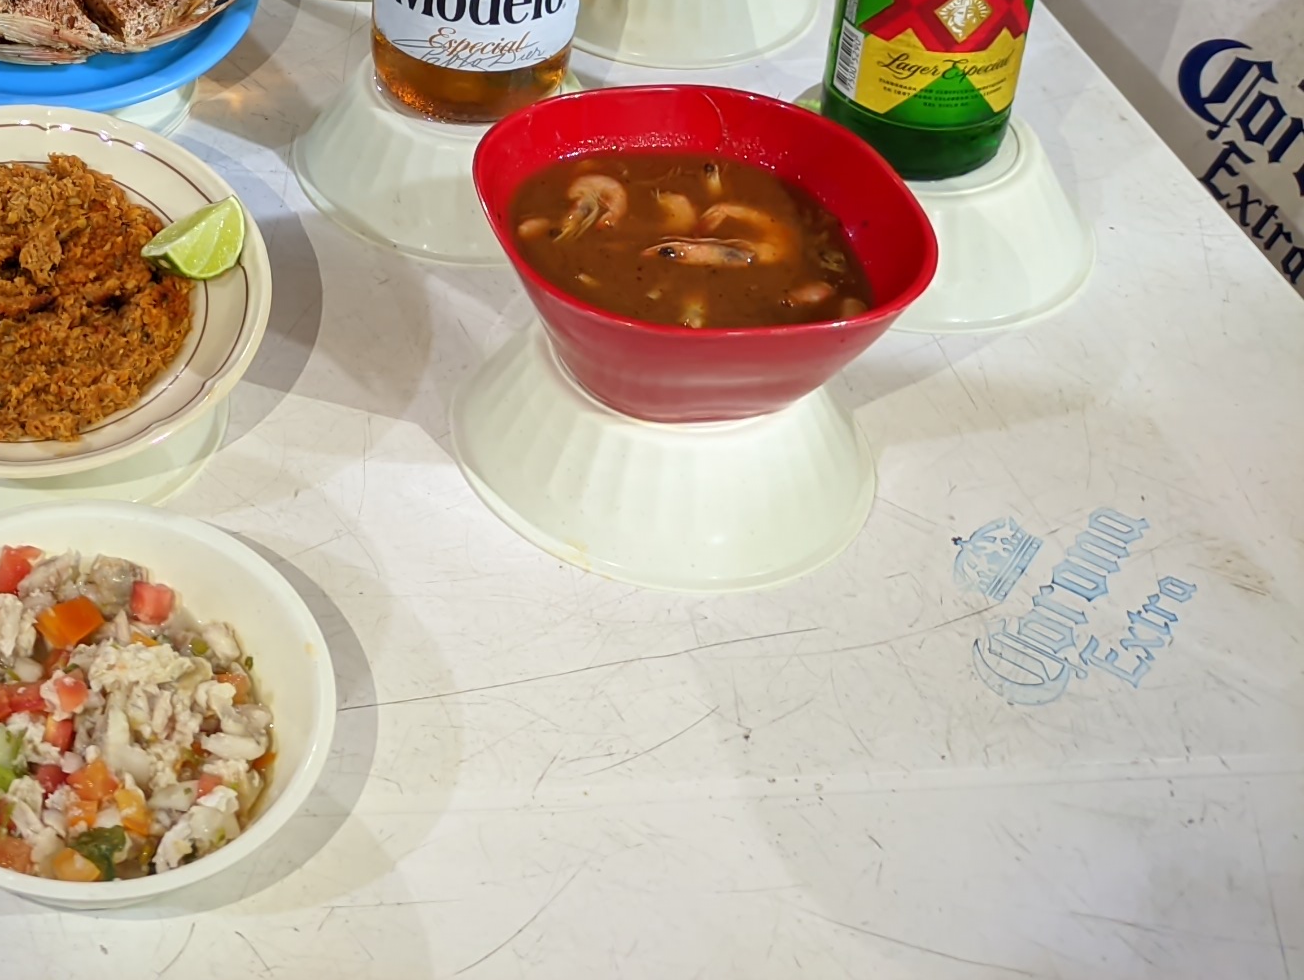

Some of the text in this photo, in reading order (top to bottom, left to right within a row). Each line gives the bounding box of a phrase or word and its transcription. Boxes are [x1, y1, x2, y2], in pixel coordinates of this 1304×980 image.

[428, 27, 531, 56] Especial
[877, 49, 1015, 84] Lager Especial
[1178, 39, 1304, 196] Cor
[972, 507, 1151, 706] Corona
[1079, 576, 1198, 689] Extra
